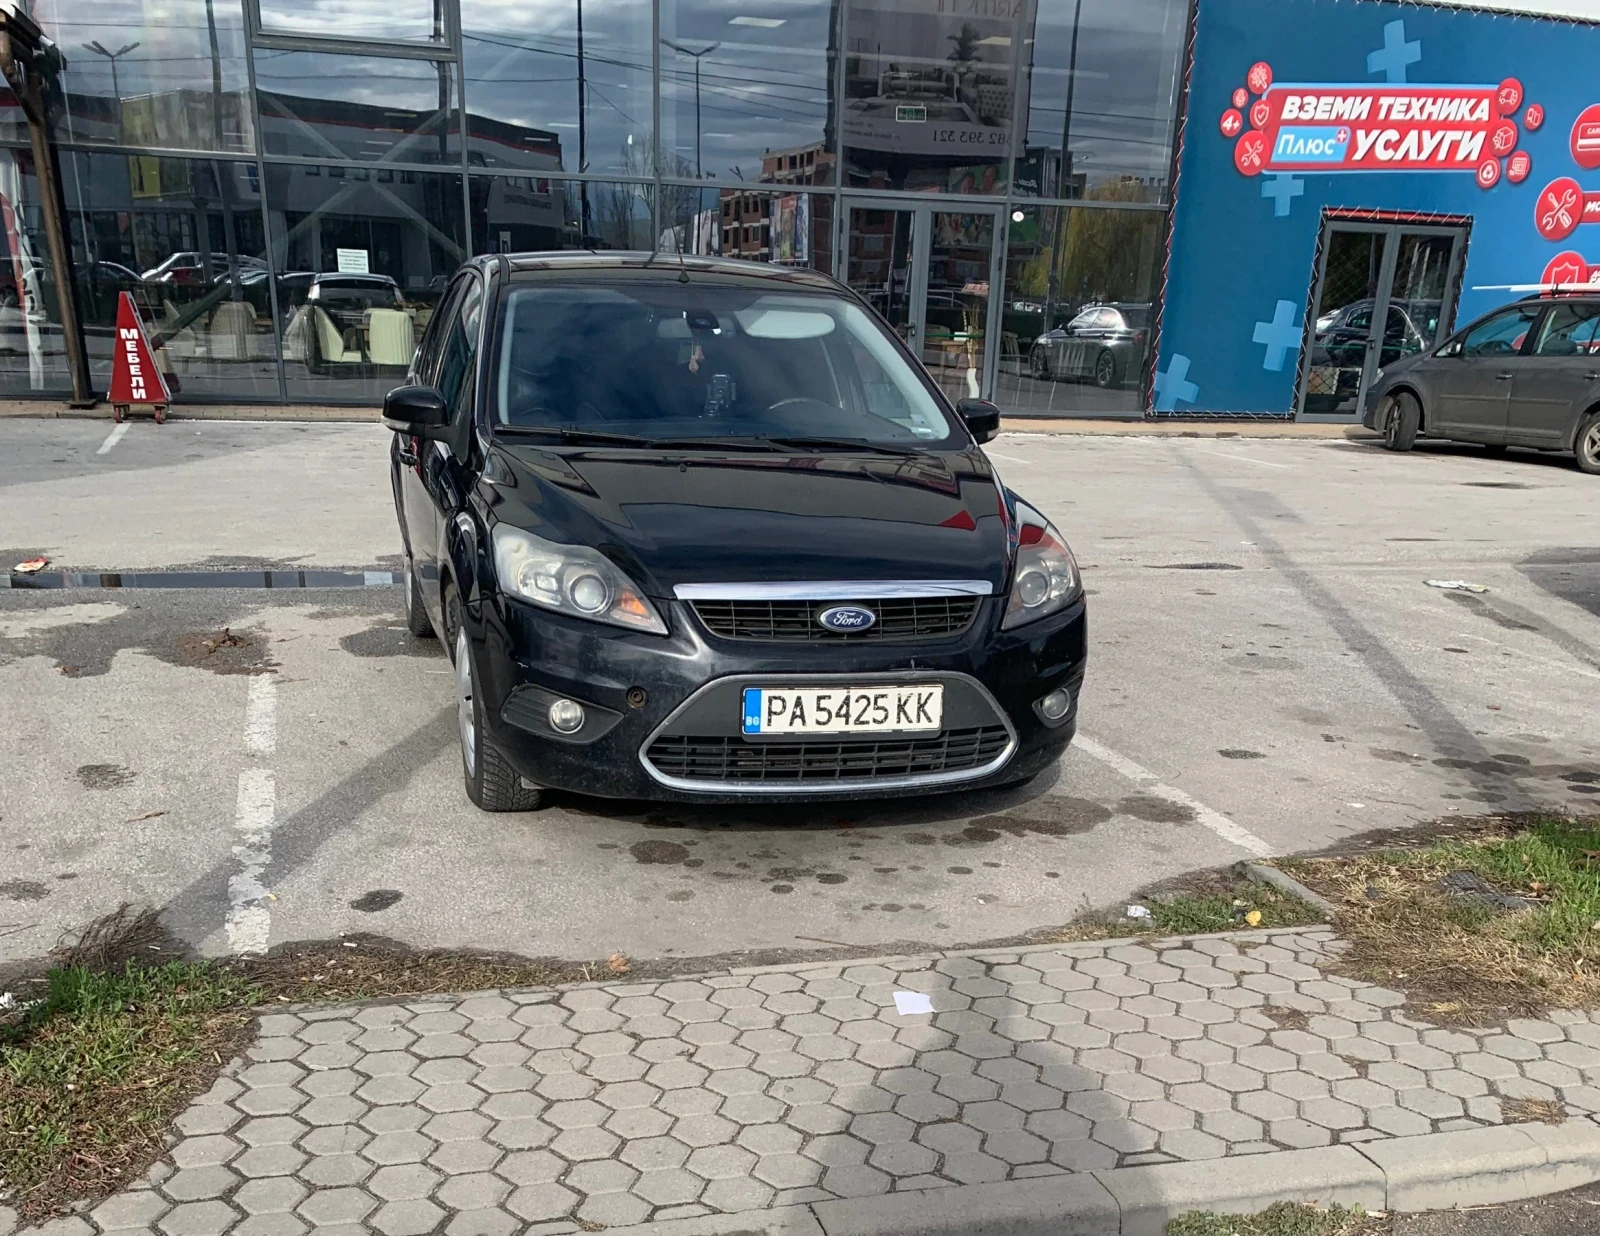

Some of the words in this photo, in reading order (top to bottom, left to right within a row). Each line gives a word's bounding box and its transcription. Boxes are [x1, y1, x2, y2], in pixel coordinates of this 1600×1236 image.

[1280, 95, 1373, 121] ВЗЕМИ
[1377, 97, 1490, 121] ТЕХНИКА
[1351, 128, 1487, 162] УСЛУГИ
[119, 328, 147, 400] МЕБЕЛИ
[833, 611, 863, 626] Ford
[745, 716, 760, 727] BG
[767, 695, 807, 727] PA
[815, 693, 889, 727] 5425
[896, 691, 934, 725] KK
